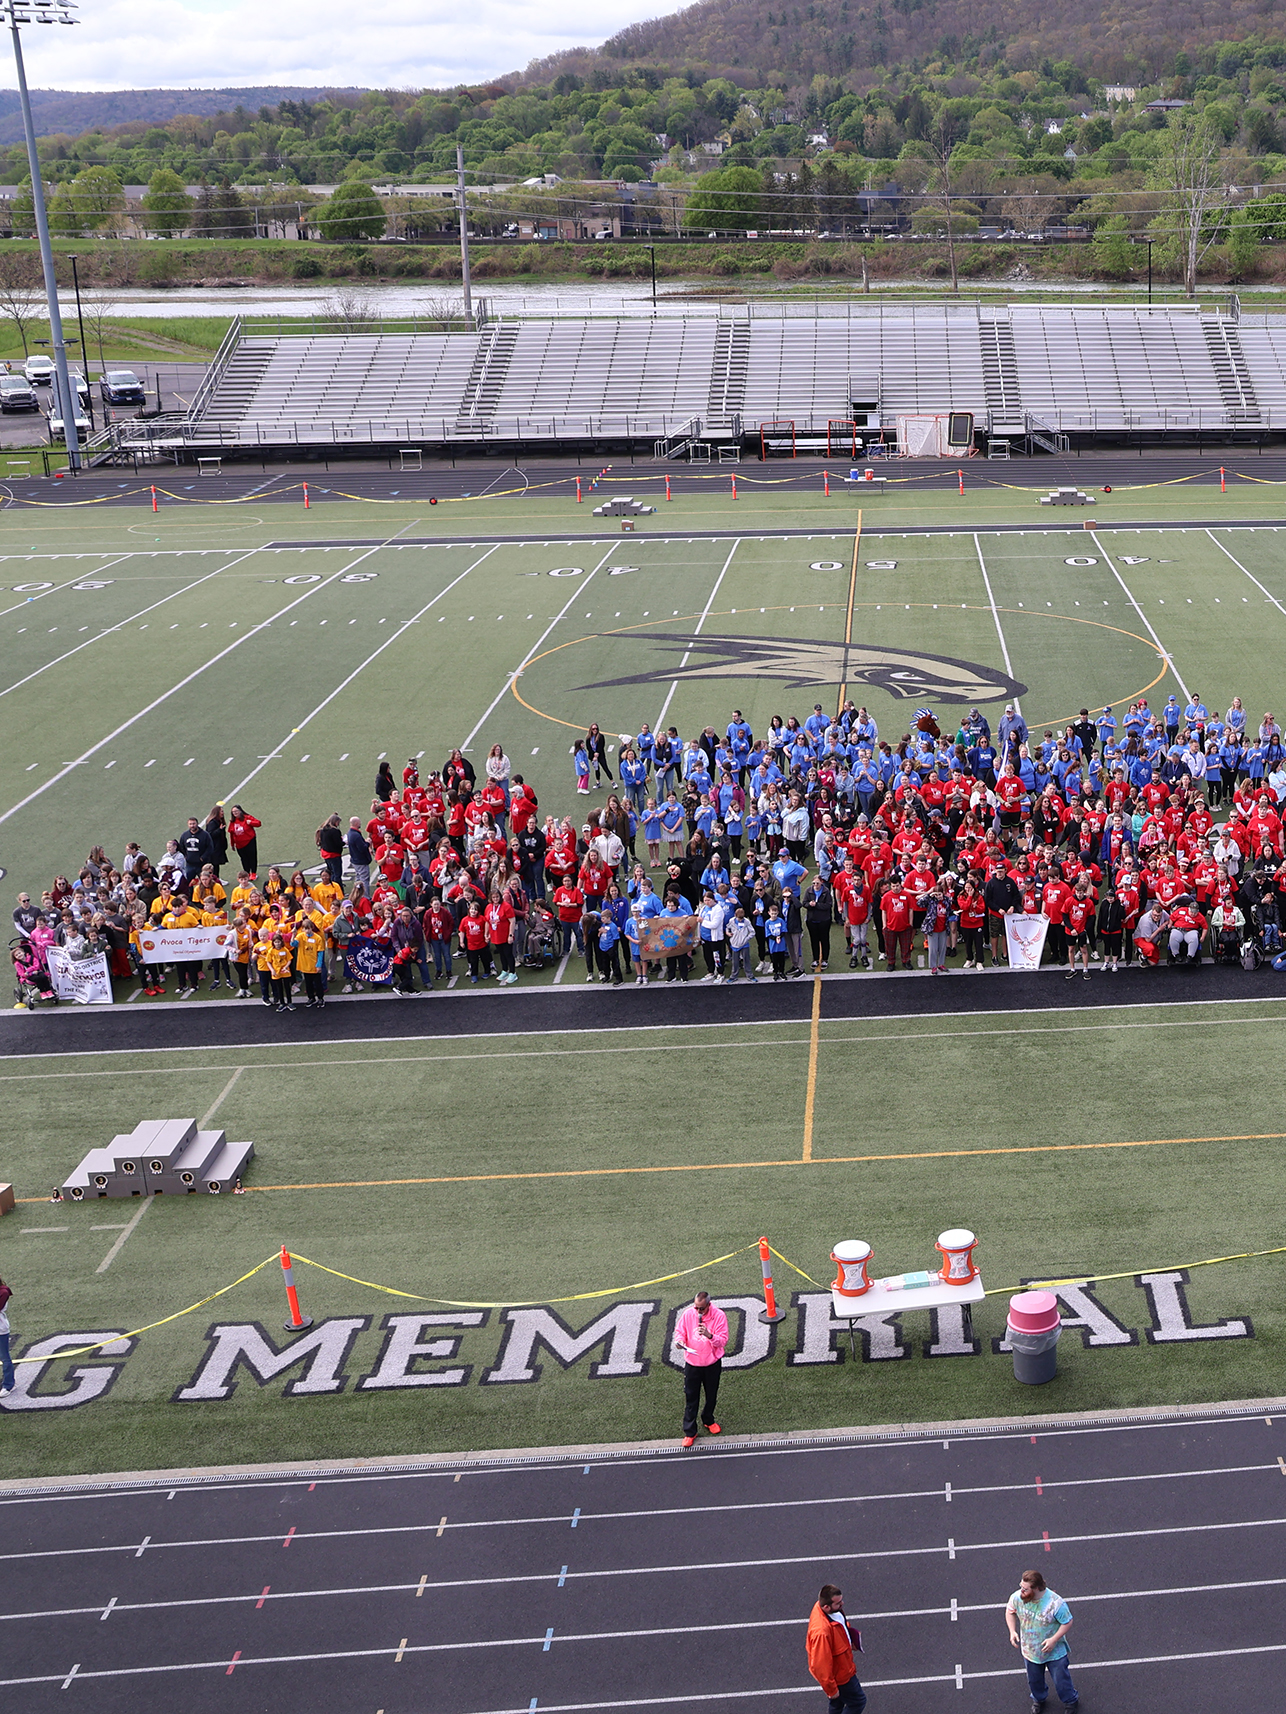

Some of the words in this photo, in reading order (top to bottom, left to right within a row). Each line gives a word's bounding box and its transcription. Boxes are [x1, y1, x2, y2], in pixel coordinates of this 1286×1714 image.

[160, 938, 183, 946] Avoca
[187, 937, 211, 946] Tigers
[82, 958, 105, 970] DISTRICT
[71, 970, 106, 981] LYMPICS
[172, 1268, 1255, 1401] MEMORIAL
